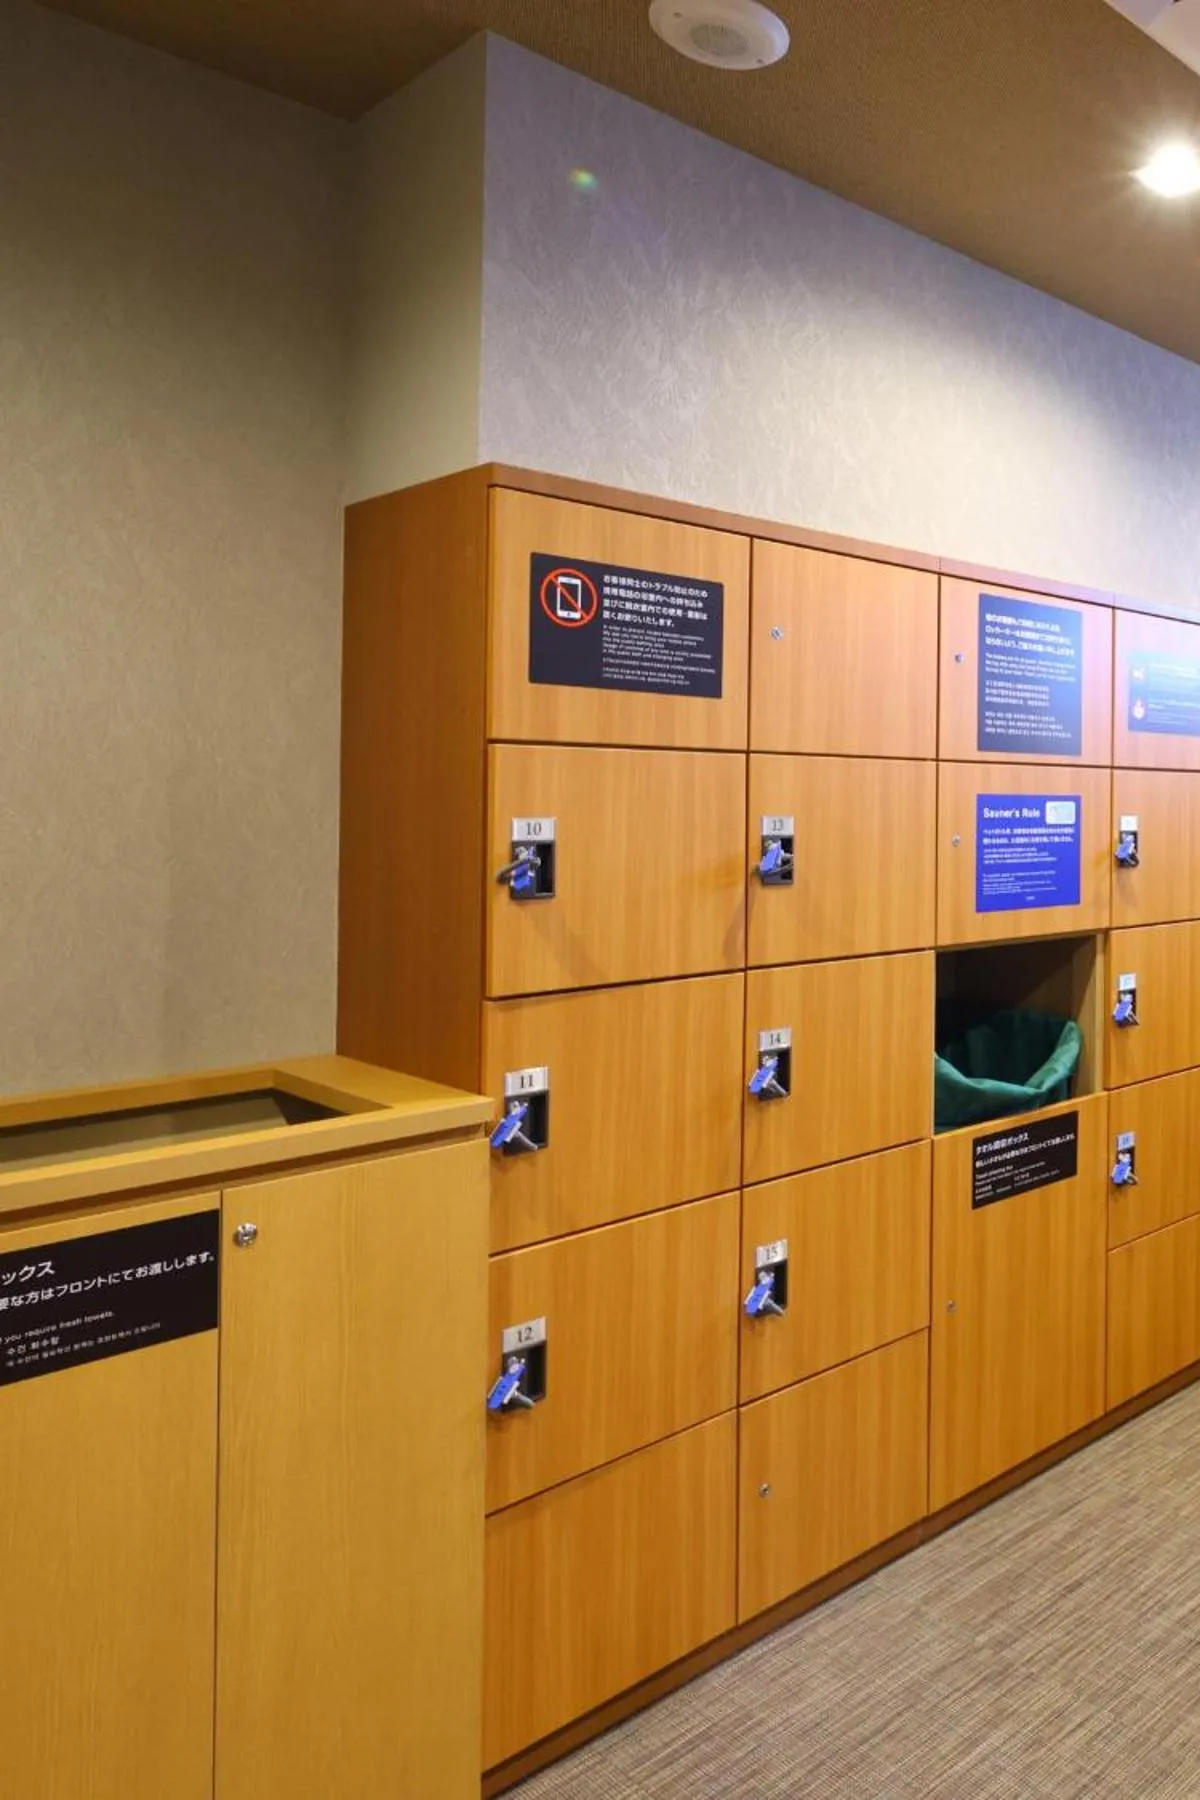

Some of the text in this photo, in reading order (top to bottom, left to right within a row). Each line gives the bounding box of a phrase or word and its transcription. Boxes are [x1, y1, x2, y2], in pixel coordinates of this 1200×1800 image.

[527, 821, 542, 836] 10
[520, 1073, 534, 1089] 11
[517, 1325, 534, 1344] 12
